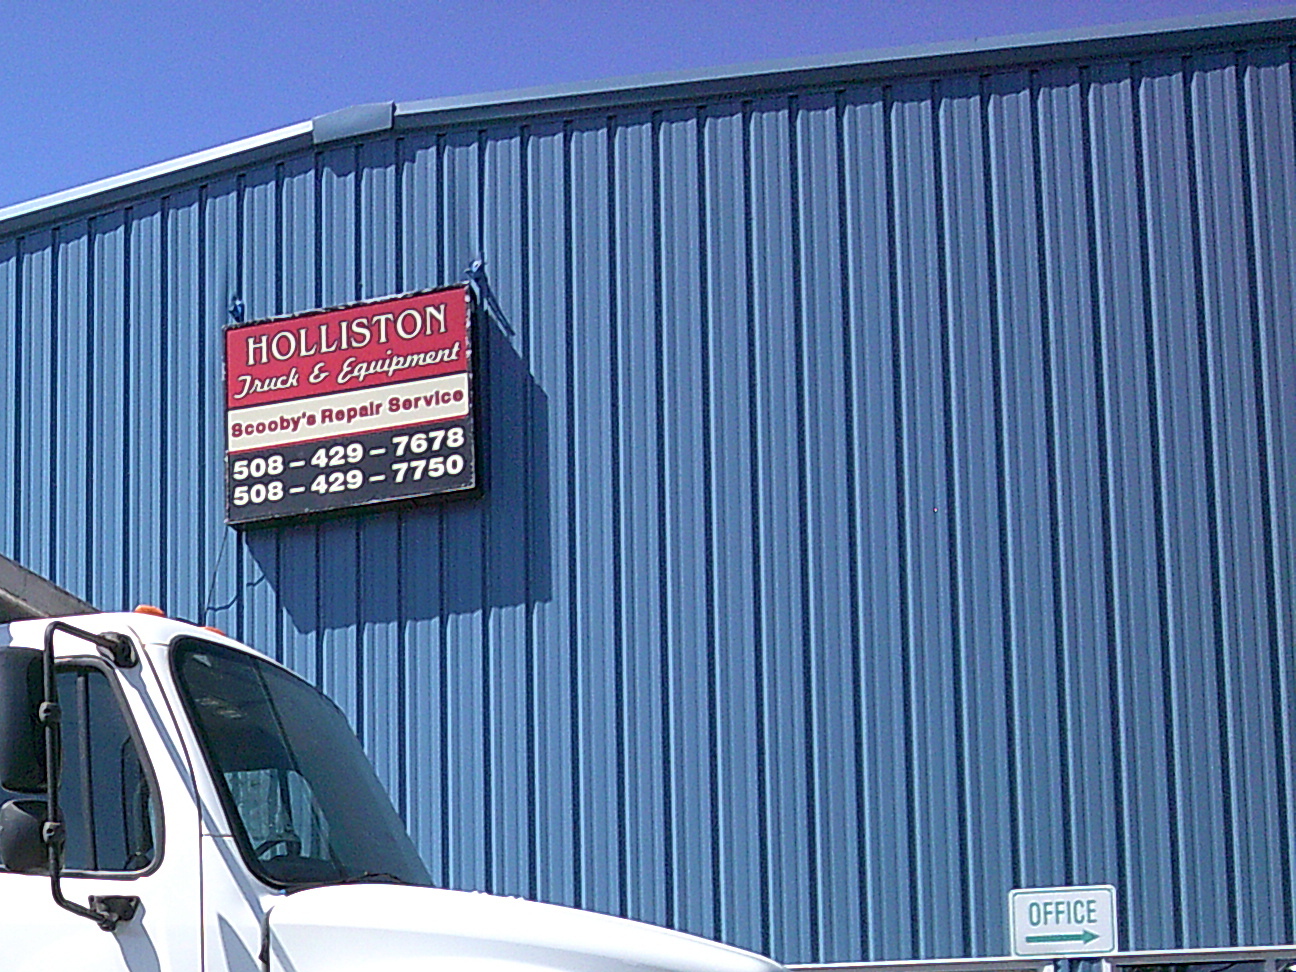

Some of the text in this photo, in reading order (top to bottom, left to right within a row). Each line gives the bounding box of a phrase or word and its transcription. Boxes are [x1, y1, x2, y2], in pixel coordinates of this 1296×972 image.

[247, 304, 447, 366] HOLLISTON
[233, 341, 461, 399] Truck & Equipment
[231, 389, 464, 438] Scooby's Repair Service
[1029, 899, 1098, 926] OFFICE
